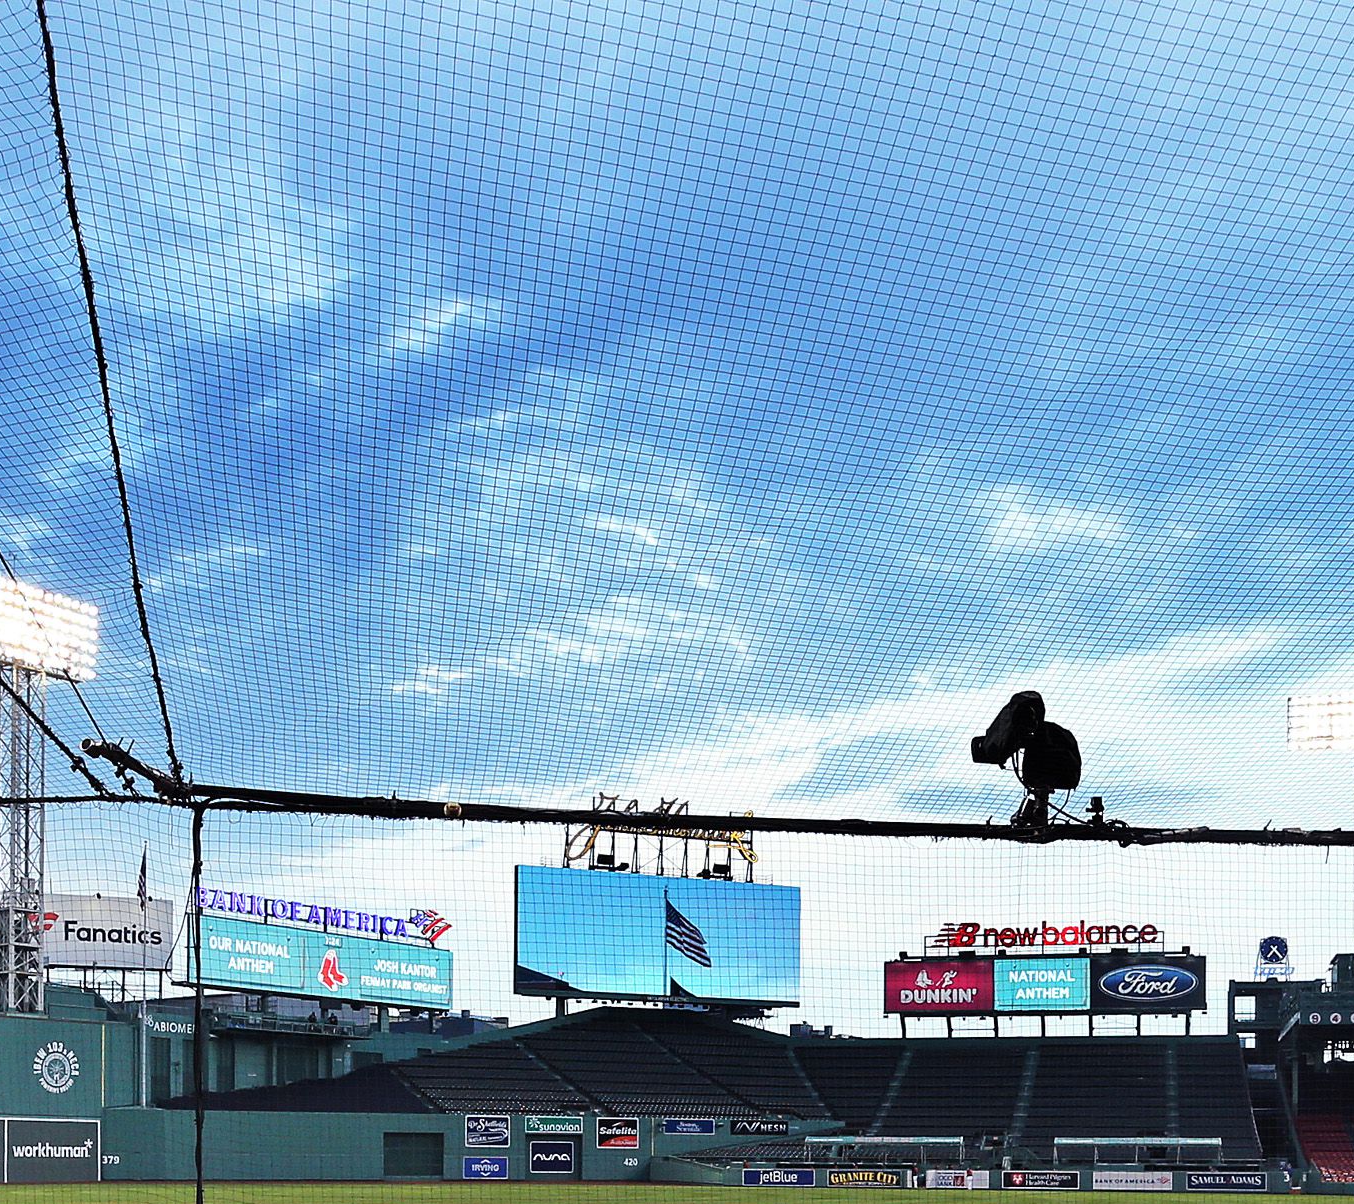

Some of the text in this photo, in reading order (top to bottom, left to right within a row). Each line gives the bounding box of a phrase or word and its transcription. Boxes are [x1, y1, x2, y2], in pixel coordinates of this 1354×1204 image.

[196, 886, 410, 939] BANK OF AMERICA
[64, 920, 163, 946] Fanatics
[983, 920, 1159, 948] new balance
[209, 935, 290, 960] OUR NATIONAL
[227, 956, 274, 975] ANTHEM
[373, 959, 437, 979] JOSH KANTOR
[1008, 968, 1075, 983] NATIONAL
[1118, 968, 1177, 996] Ford
[900, 987, 977, 1005] DUNKIN'
[1016, 986, 1070, 1000] ANTHEM
[153, 1022, 195, 1034] ABIOME
[539, 1122, 580, 1132] sunovion
[599, 1127, 637, 1135] Safelite
[760, 1123, 787, 1132] NESN
[12, 1141, 91, 1159] workhuman
[102, 1155, 120, 1164] 379
[532, 1153, 571, 1162] nuna
[623, 1158, 638, 1167] 420
[472, 1164, 499, 1172] IRVING
[758, 1170, 798, 1184] jetBlue
[830, 1172, 900, 1185] GRANITE CITY
[1190, 1175, 1262, 1187] SAMUEL ADAMS
